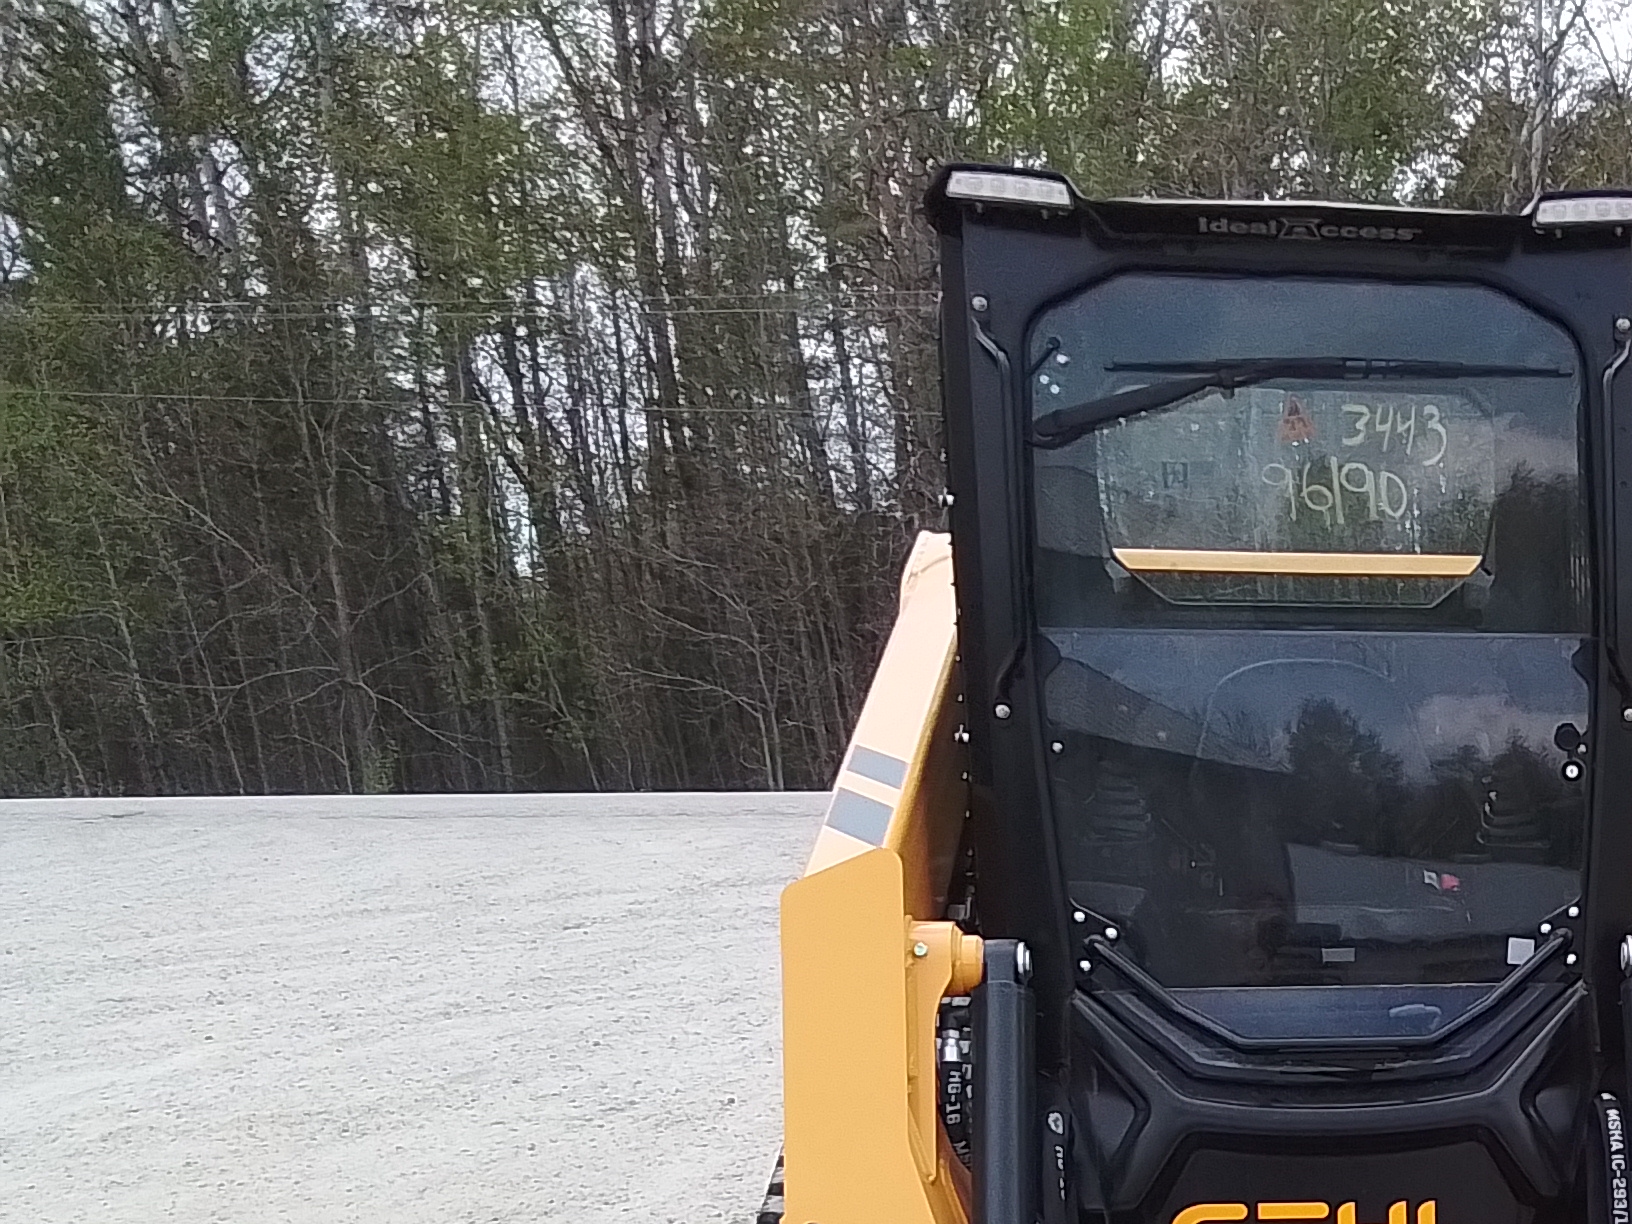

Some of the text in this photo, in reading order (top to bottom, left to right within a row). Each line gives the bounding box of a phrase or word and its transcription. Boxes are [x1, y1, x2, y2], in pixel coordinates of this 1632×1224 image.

[1341, 404, 1447, 466] 3443
[1262, 456, 1407, 526] 96190
[1606, 1108, 1624, 1152] MSHA
